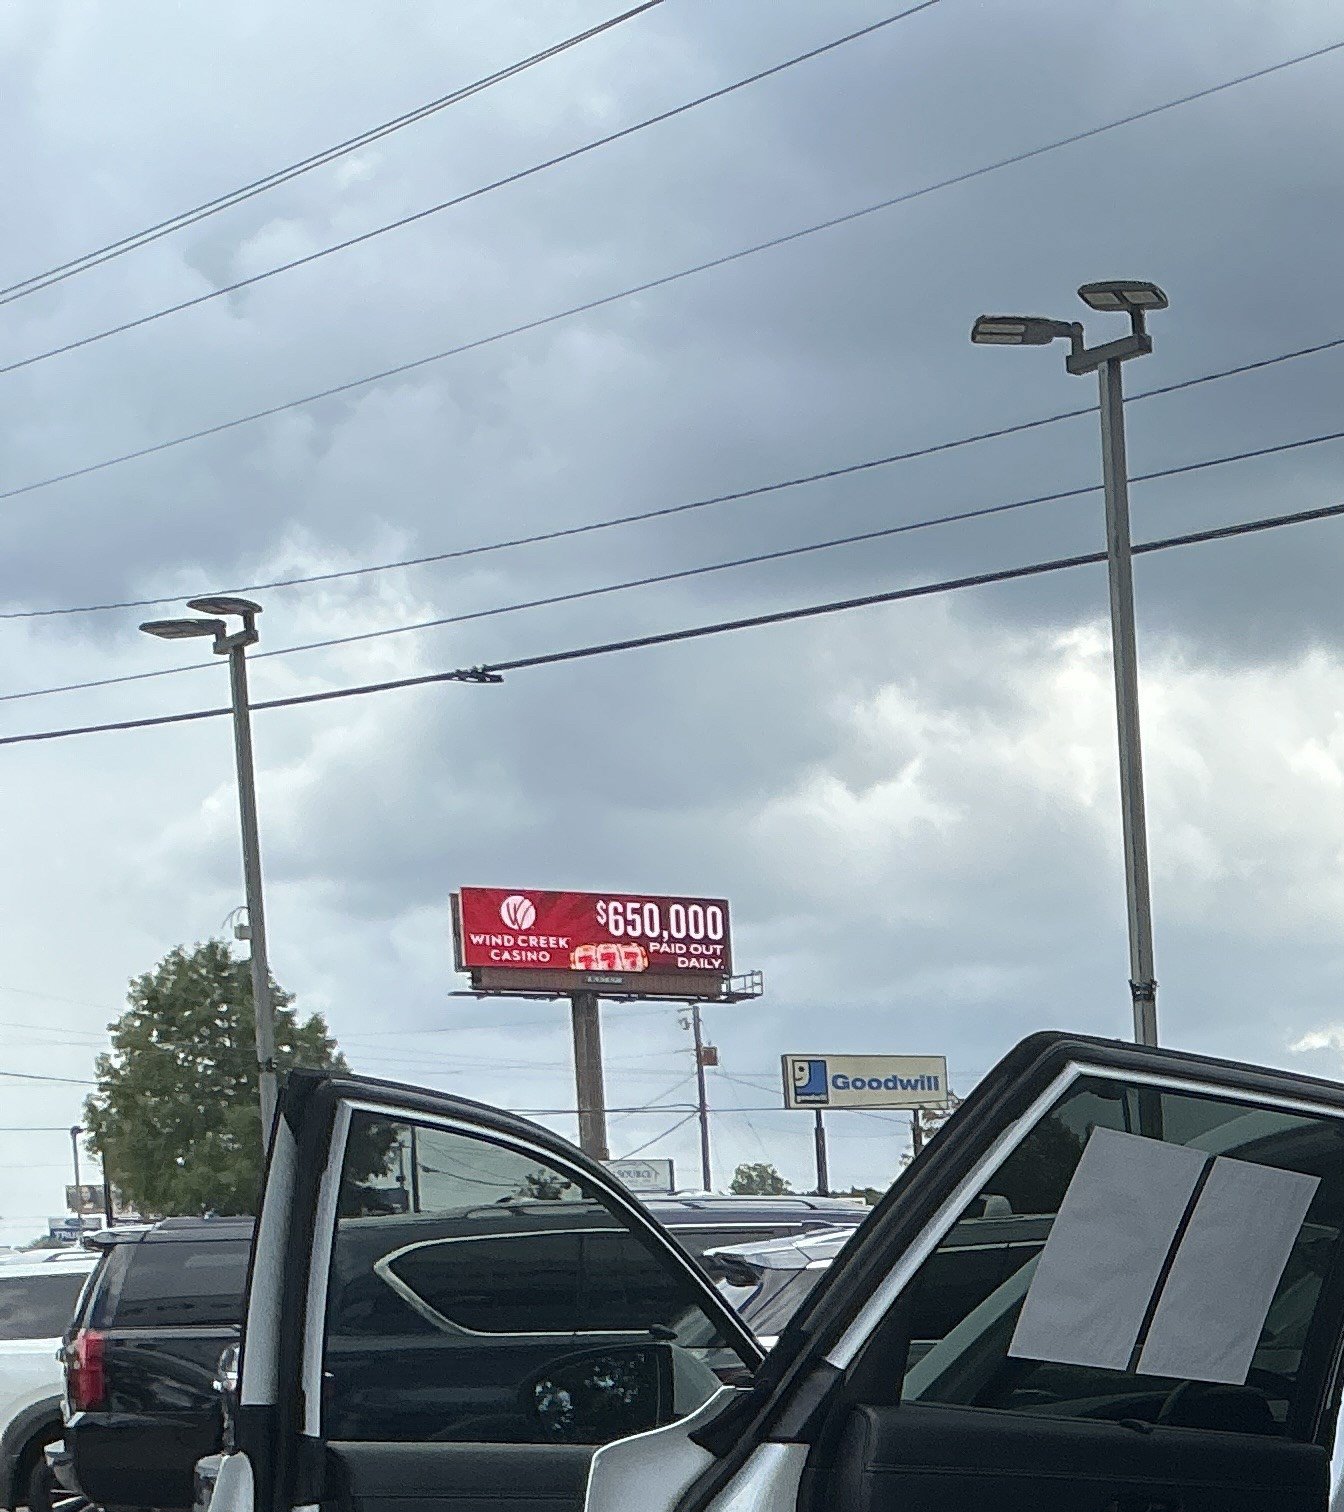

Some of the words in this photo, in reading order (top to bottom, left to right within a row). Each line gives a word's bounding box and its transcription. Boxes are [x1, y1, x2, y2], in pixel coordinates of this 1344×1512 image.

[596, 900, 724, 943] $650,000
[470, 933, 515, 947] WIND
[517, 935, 570, 949] CREEK
[650, 942, 687, 954] PAID
[690, 944, 724, 955] OUT
[490, 949, 550, 962] CASINO
[831, 1074, 940, 1091] Goodwill
